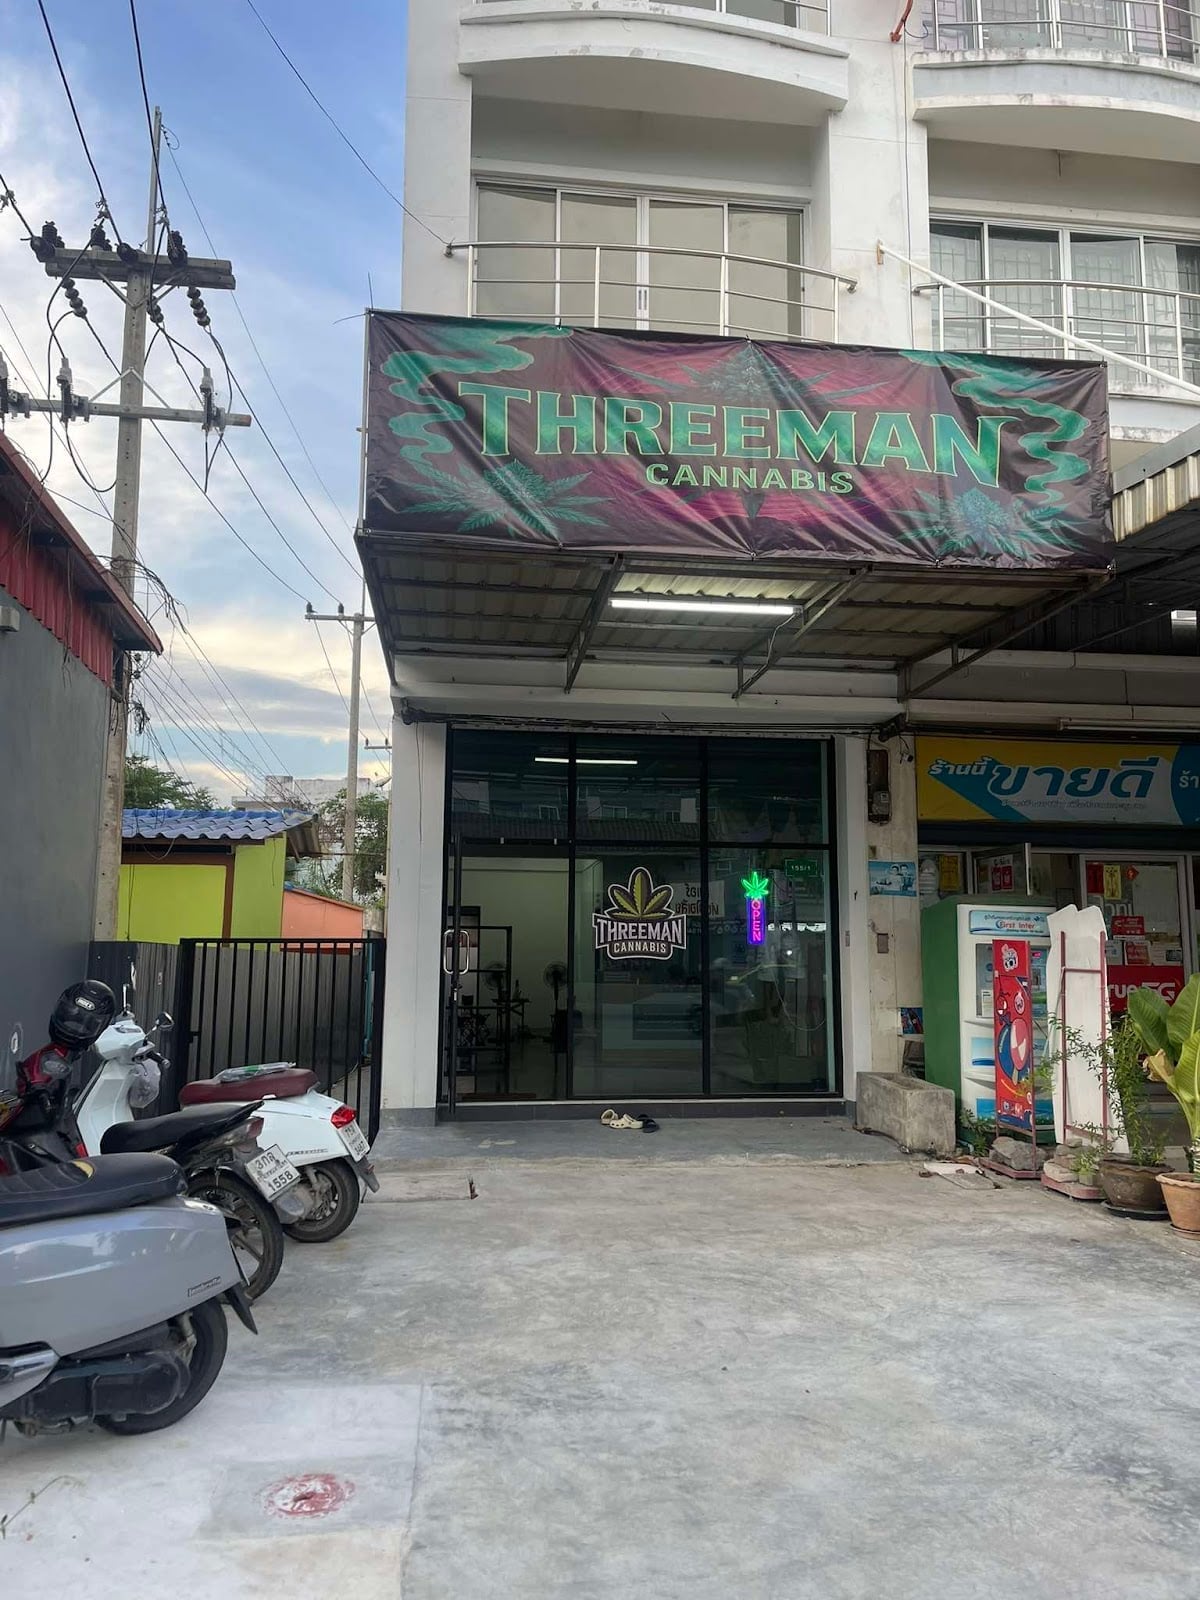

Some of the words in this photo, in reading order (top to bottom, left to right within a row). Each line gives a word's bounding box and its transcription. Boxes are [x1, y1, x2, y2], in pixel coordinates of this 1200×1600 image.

[457, 381, 1022, 488] THREEMAN
[645, 463, 853, 494] CANNABIS
[928, 755, 992, 776] ร้านนี้
[987, 755, 1160, 798] ขายดี
[596, 918, 684, 944] THREEMAN
[751, 899, 762, 942] OPEN
[613, 941, 667, 953] CANNABIS
[268, 1170, 293, 1191] 1558
